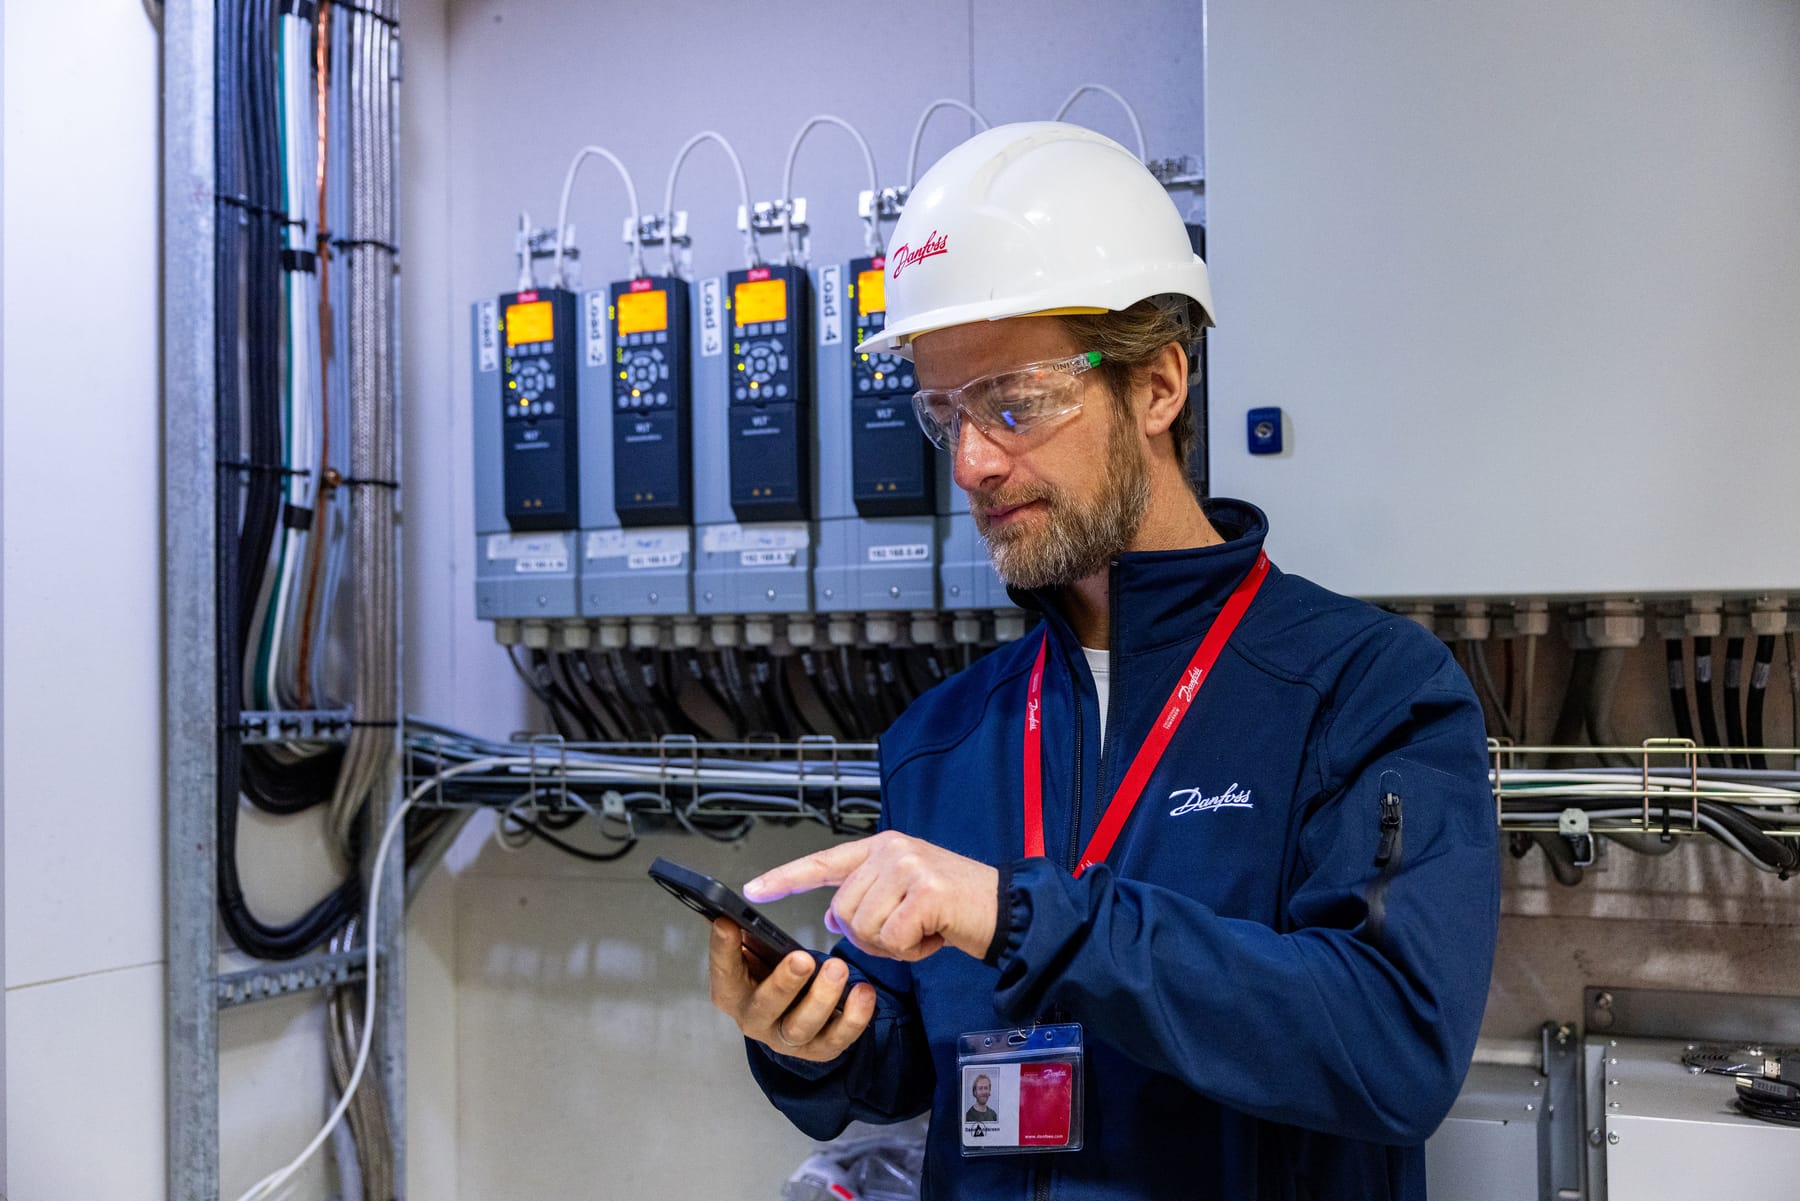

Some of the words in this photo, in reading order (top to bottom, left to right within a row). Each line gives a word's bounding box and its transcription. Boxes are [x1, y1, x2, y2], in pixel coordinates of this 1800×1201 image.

[893, 230, 948, 279] Danfoss
[704, 281, 716, 329] Load
[823, 267, 837, 317] Load
[590, 292, 601, 341] Load
[1178, 666, 1203, 702] Danfoss
[1169, 783, 1254, 816] Danfoss
